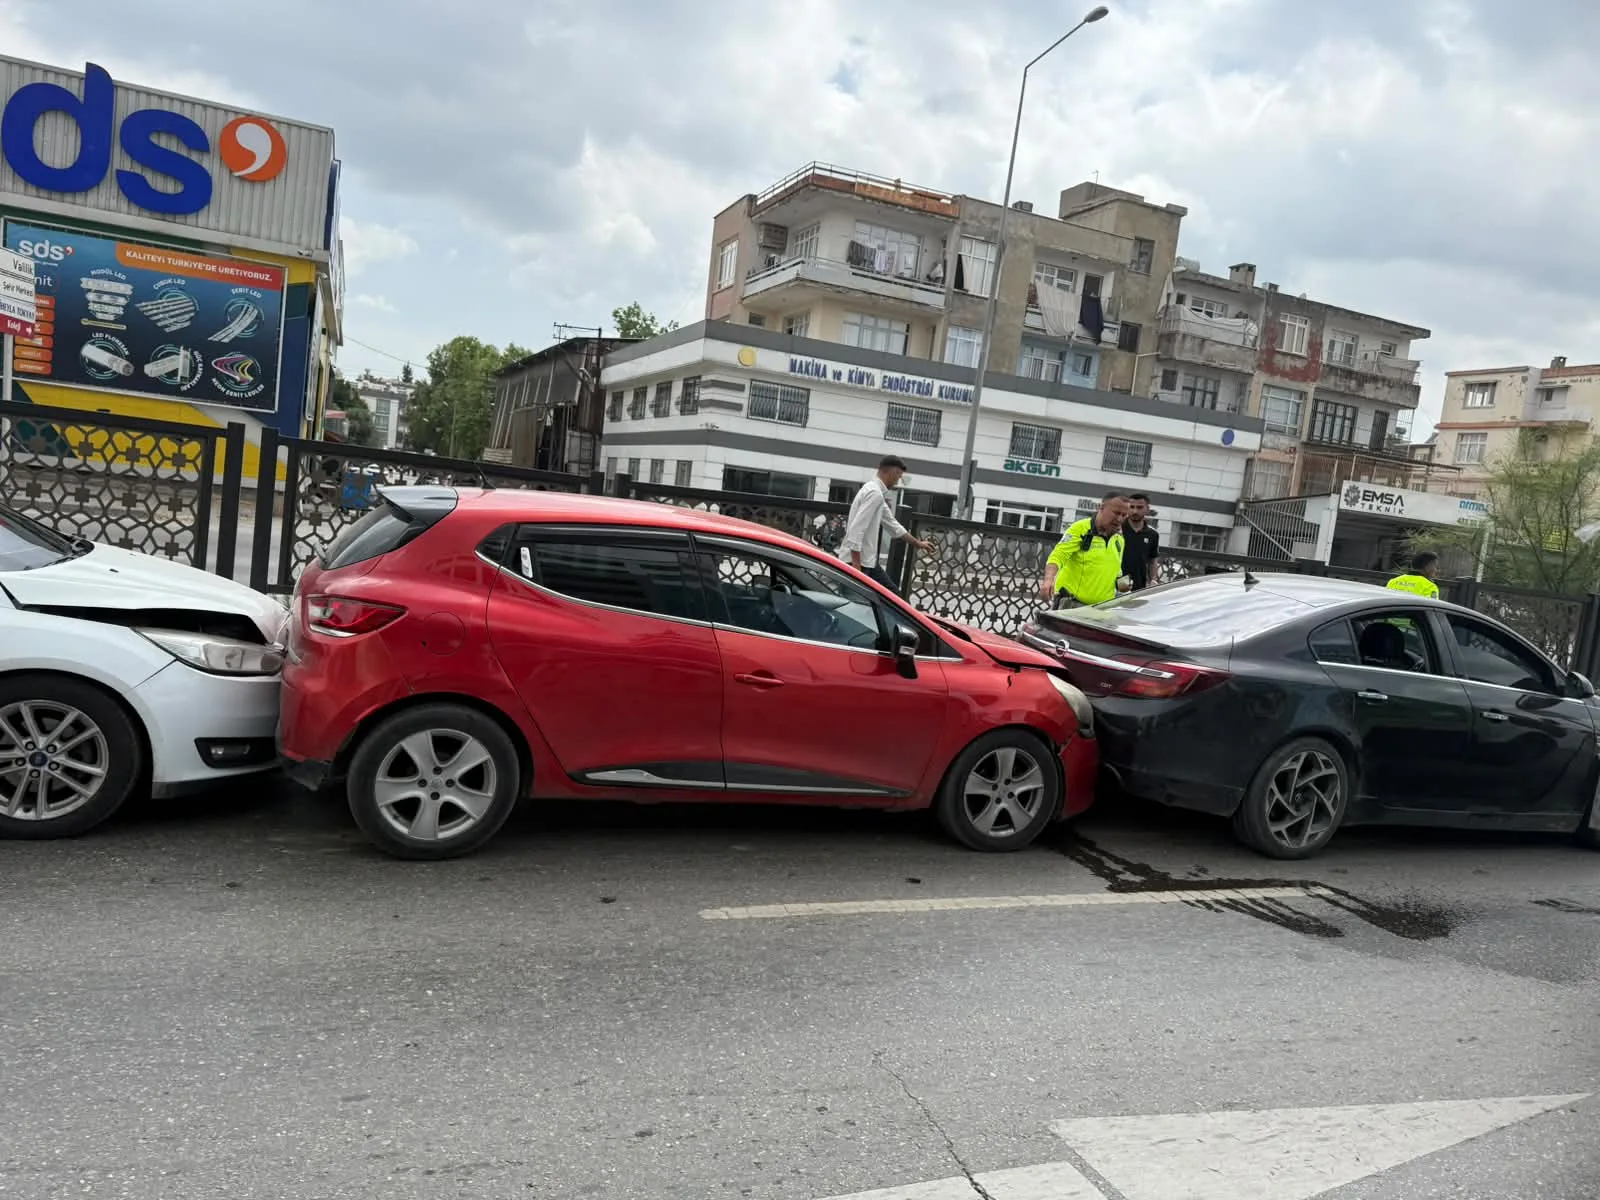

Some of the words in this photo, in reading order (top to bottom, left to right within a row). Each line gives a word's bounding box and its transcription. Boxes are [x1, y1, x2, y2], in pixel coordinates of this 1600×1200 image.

[18, 240, 65, 260] sds
[790, 358, 827, 379] MAKİNA
[832, 369, 842, 381] ve
[848, 367, 875, 387] KİMYA
[881, 375, 935, 397] ENDÜSTRİSİ
[1362, 489, 1404, 507] EMSA
